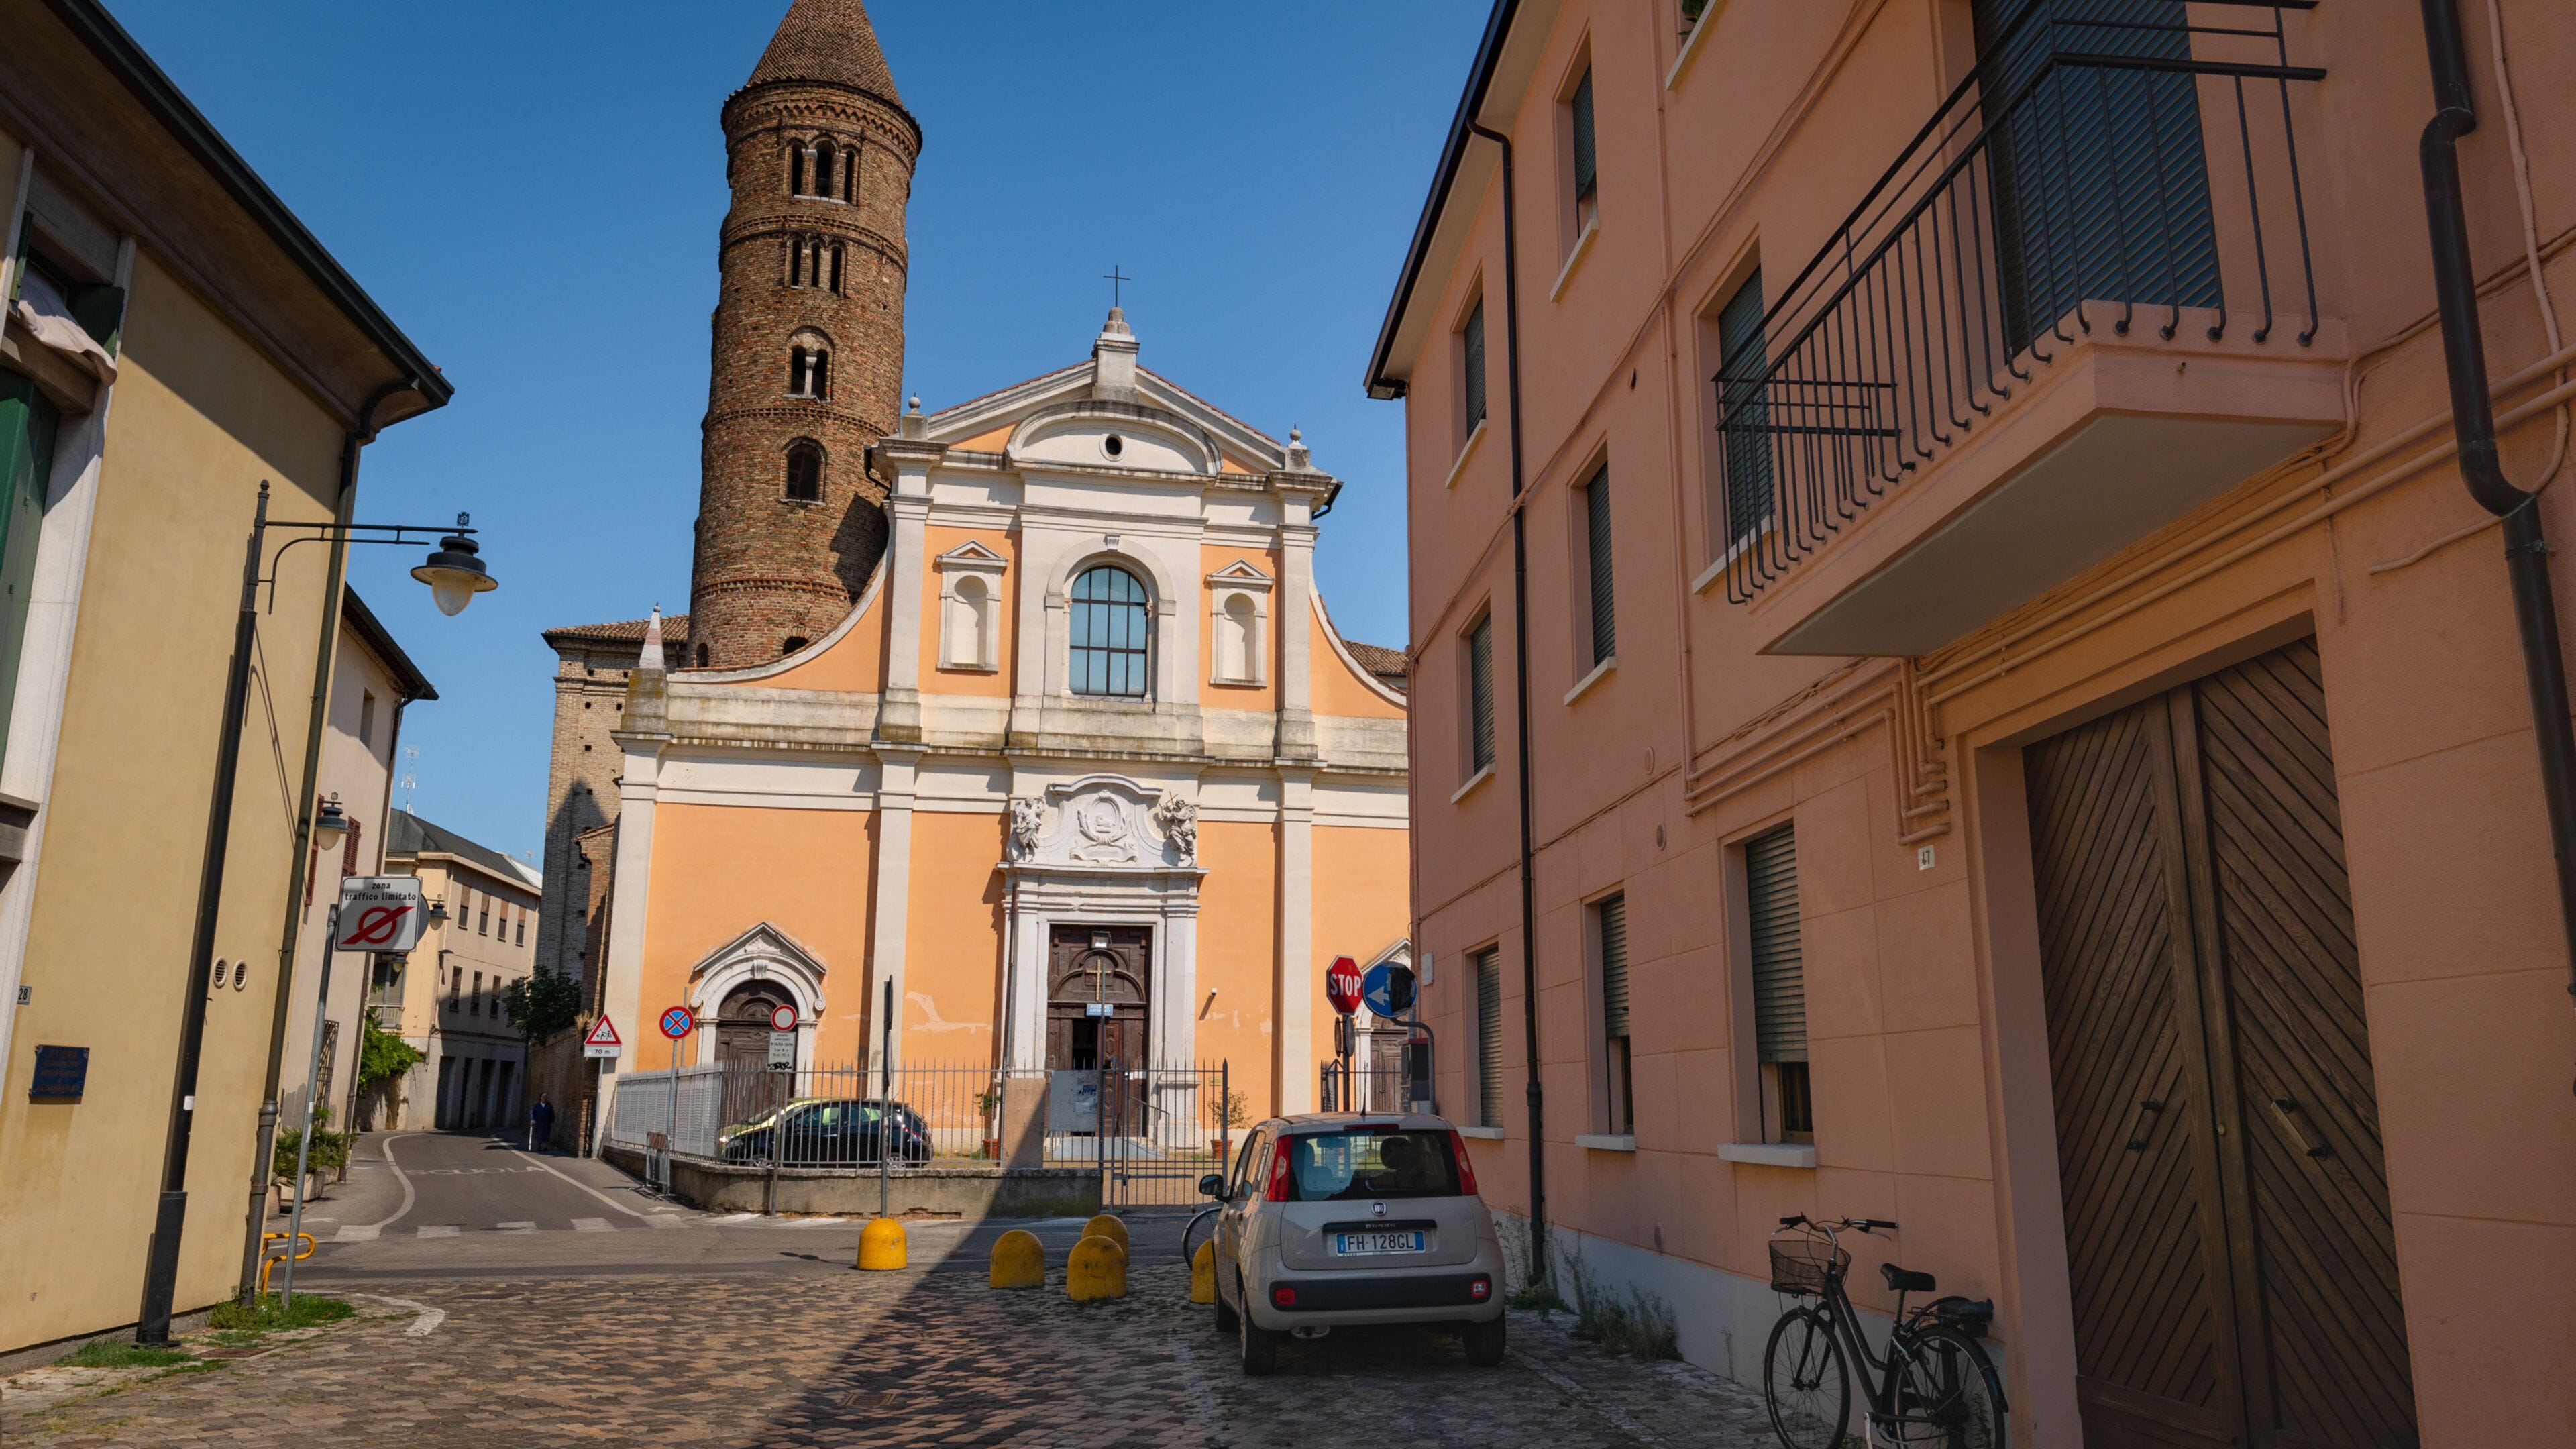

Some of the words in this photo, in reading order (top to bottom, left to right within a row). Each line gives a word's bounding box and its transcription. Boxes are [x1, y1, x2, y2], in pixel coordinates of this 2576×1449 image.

[345, 892, 378, 900] traffico
[381, 892, 417, 900] limitato
[1330, 973, 1362, 997] STOP
[18, 987, 28, 1000] 28
[402, 1166, 546, 1175] SCUOLA
